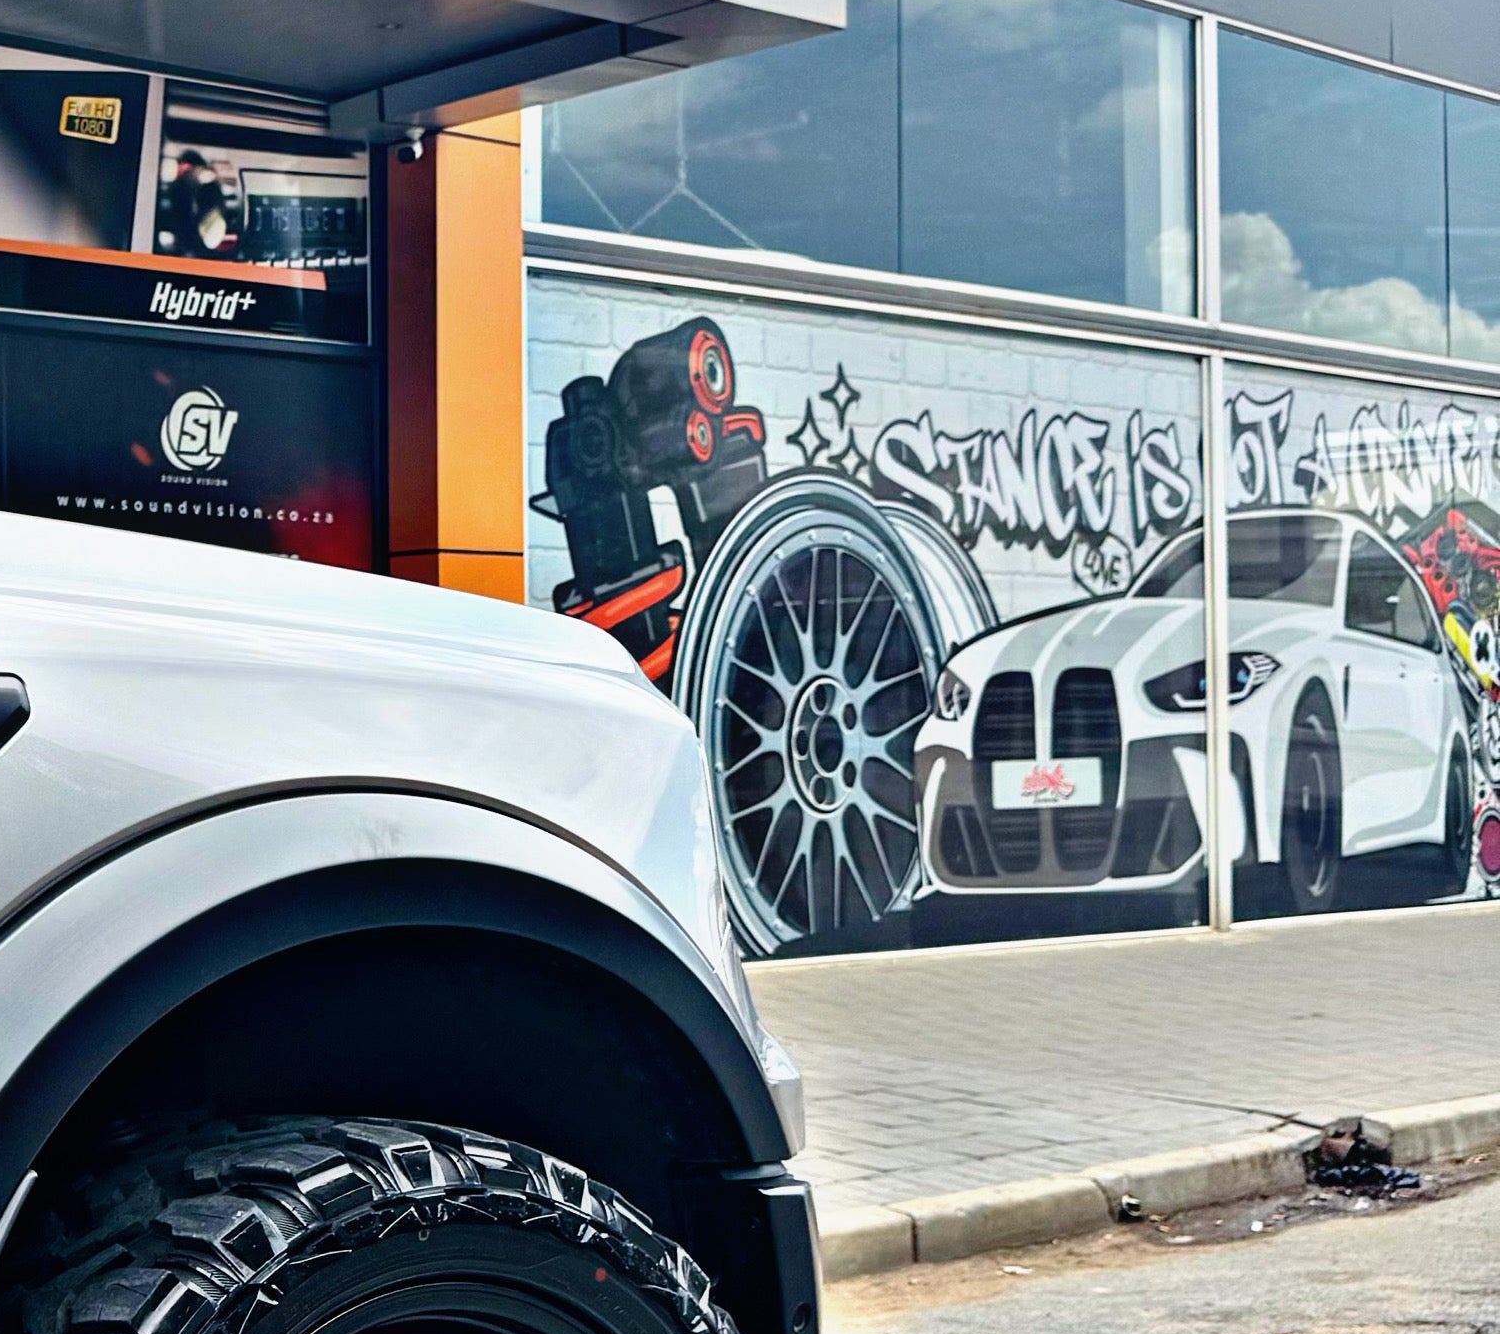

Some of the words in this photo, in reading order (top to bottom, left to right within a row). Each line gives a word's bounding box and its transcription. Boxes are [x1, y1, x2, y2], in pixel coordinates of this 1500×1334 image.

[73, 117, 107, 136] 1080
[149, 281, 257, 322] Hybrid+
[871, 408, 1116, 555] STANCE
[1197, 387, 1295, 509] OT
[56, 495, 335, 525] www.soundvision.co.za
